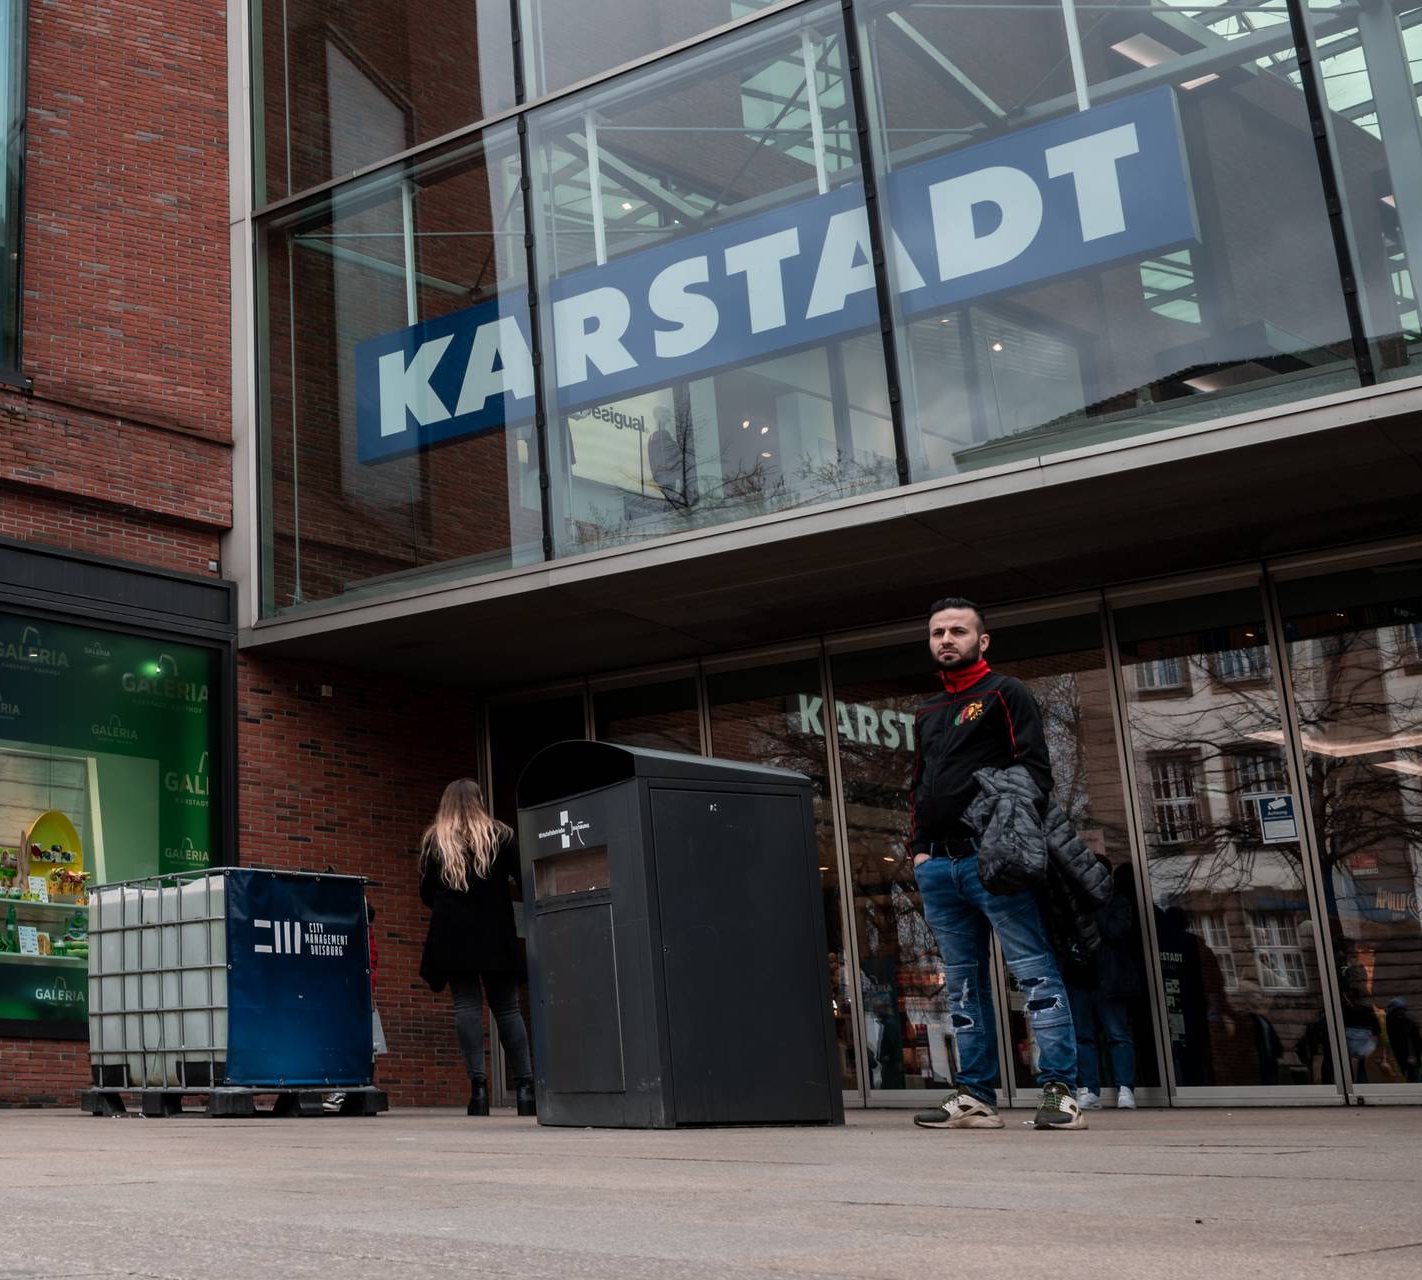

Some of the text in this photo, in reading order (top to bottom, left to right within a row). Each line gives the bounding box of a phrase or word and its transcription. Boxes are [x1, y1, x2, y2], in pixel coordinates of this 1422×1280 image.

[378, 122, 1140, 437] KARSTADT
[122, 672, 208, 703] GALERIA
[798, 693, 915, 752] KARST
[91, 723, 138, 740] GALERIA
[164, 771, 209, 796] GAL
[164, 847, 209, 862] GALERIA
[309, 922, 323, 933] CITY
[304, 933, 348, 946] MANAGEMENT
[310, 945, 343, 956] DUISBURG
[35, 988, 85, 1002] GALERIA
